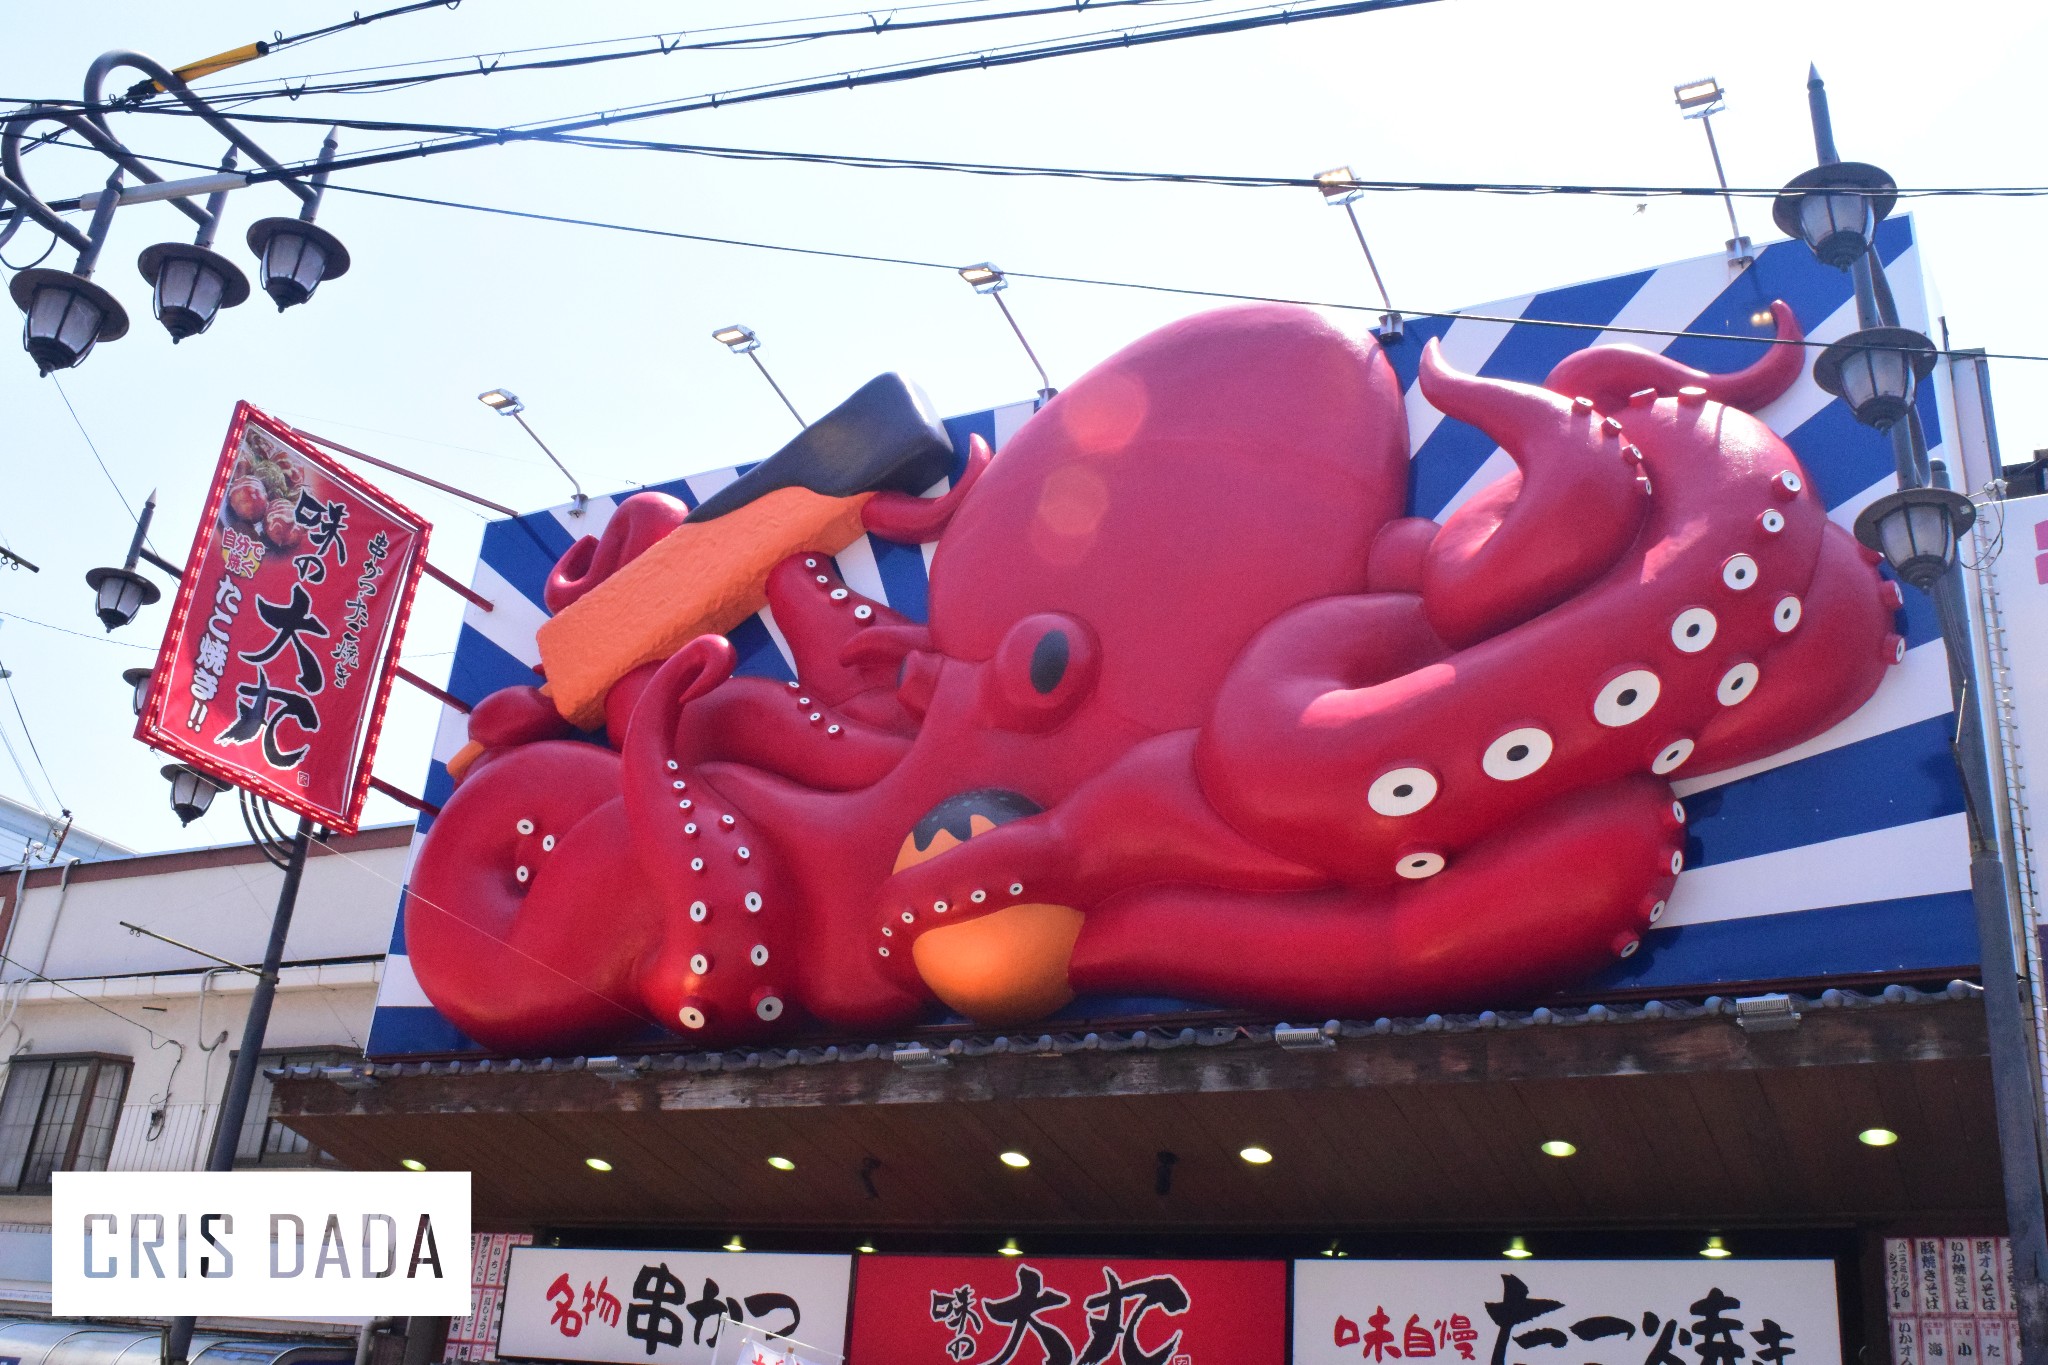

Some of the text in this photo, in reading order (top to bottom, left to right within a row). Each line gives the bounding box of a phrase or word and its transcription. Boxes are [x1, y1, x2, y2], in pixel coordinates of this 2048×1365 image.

[222, 527, 265, 561] 自分で
[225, 549, 255, 579] 焼く
